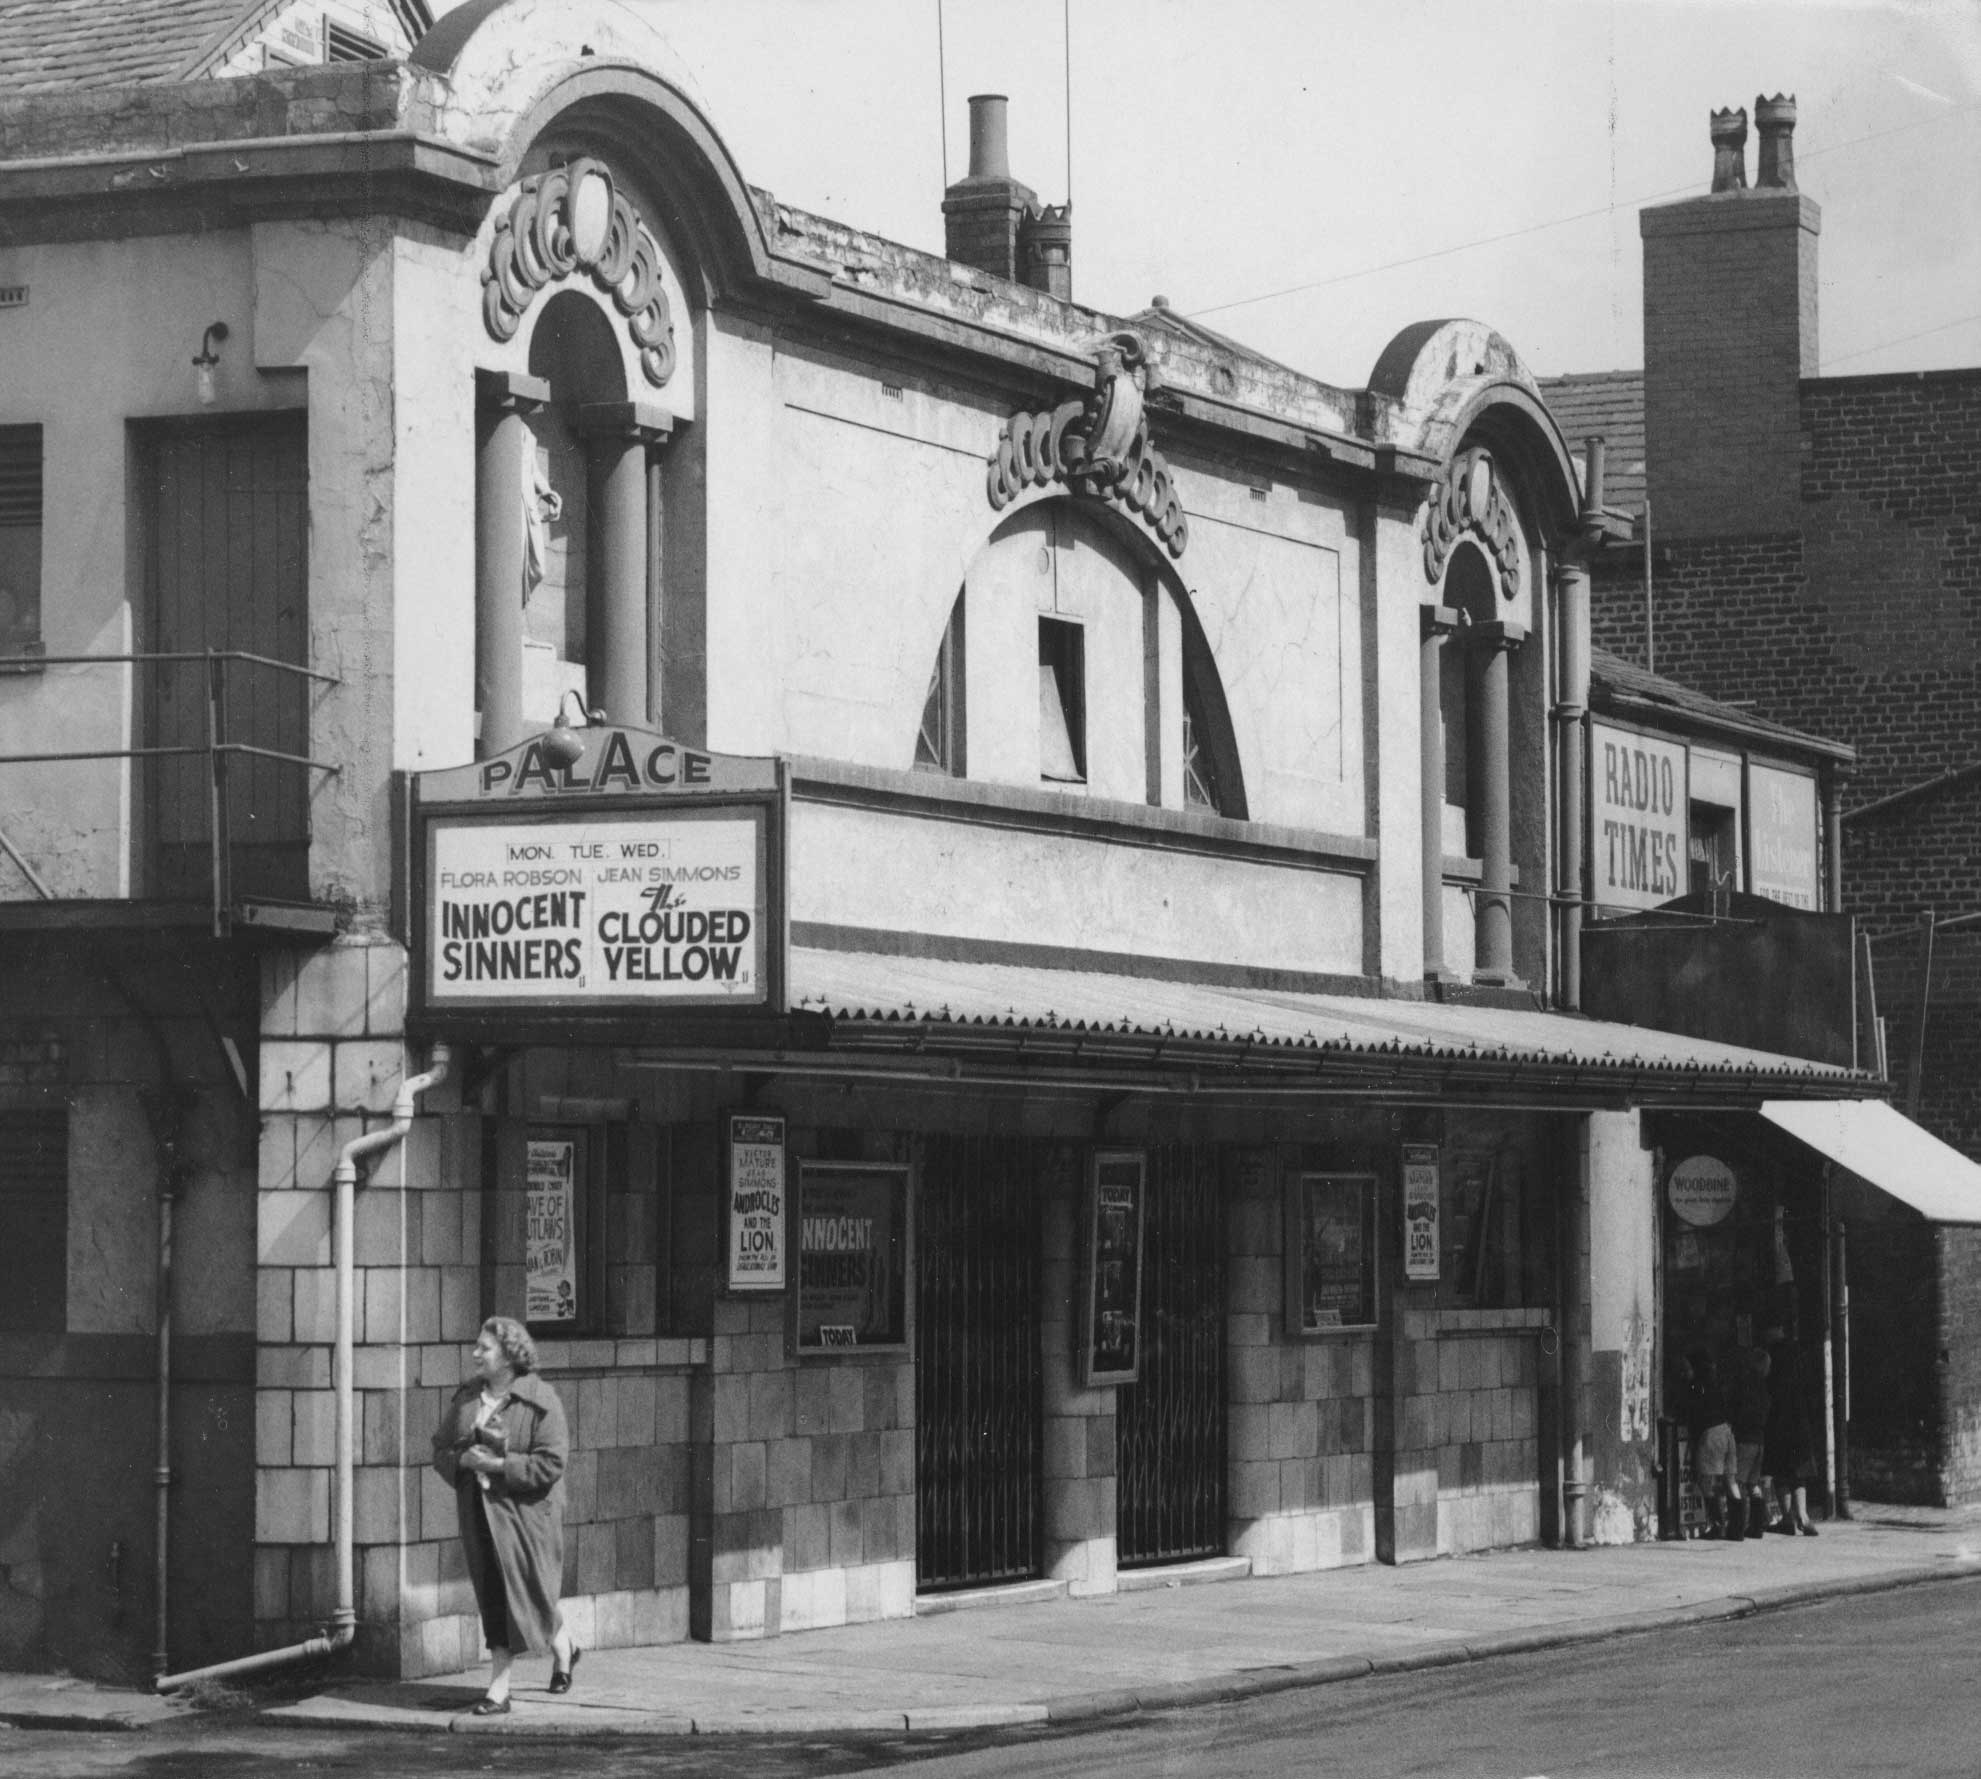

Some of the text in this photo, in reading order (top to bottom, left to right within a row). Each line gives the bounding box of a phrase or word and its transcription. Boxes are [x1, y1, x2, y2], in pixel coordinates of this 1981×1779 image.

[481, 731, 711, 794] PALACE
[1604, 741, 1673, 817] RADIO
[509, 843, 666, 861] MON. TUE. WED.
[1604, 819, 1677, 897] TIMES
[441, 867, 582, 889] FLORA ROBSON
[597, 865, 741, 883] JEAN SIMMONS
[442, 891, 586, 940] INNOCENT
[598, 910, 751, 945] CLOUDED
[443, 938, 582, 981] SINNERS
[603, 946, 743, 981] YELLOW
[733, 1190, 780, 1217] ANDROCLES
[801, 1216, 873, 1251] NNOCENT
[1411, 1233, 1433, 1251] LION
[822, 1328, 854, 1346] TODAY
